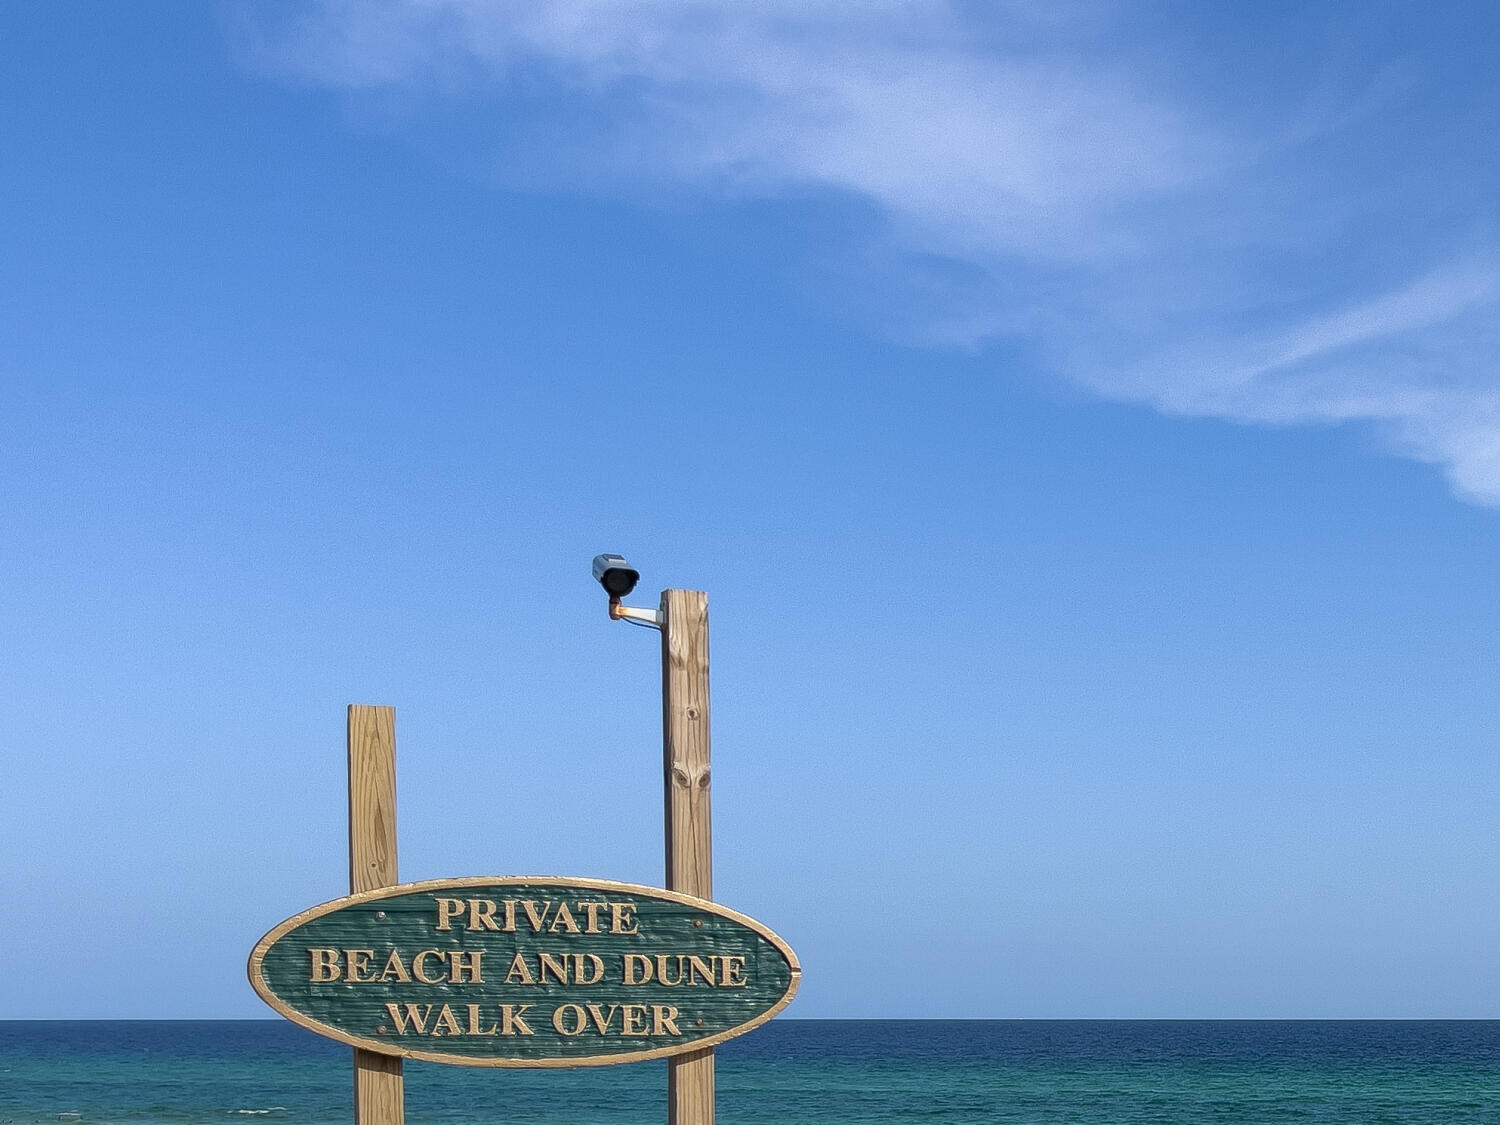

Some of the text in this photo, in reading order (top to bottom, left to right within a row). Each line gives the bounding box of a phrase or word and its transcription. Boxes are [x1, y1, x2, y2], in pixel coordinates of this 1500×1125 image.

[435, 898, 640, 935] PRIVATE
[308, 948, 747, 987] BEACH AND DUNE
[385, 1002, 682, 1038] WALK OVER
